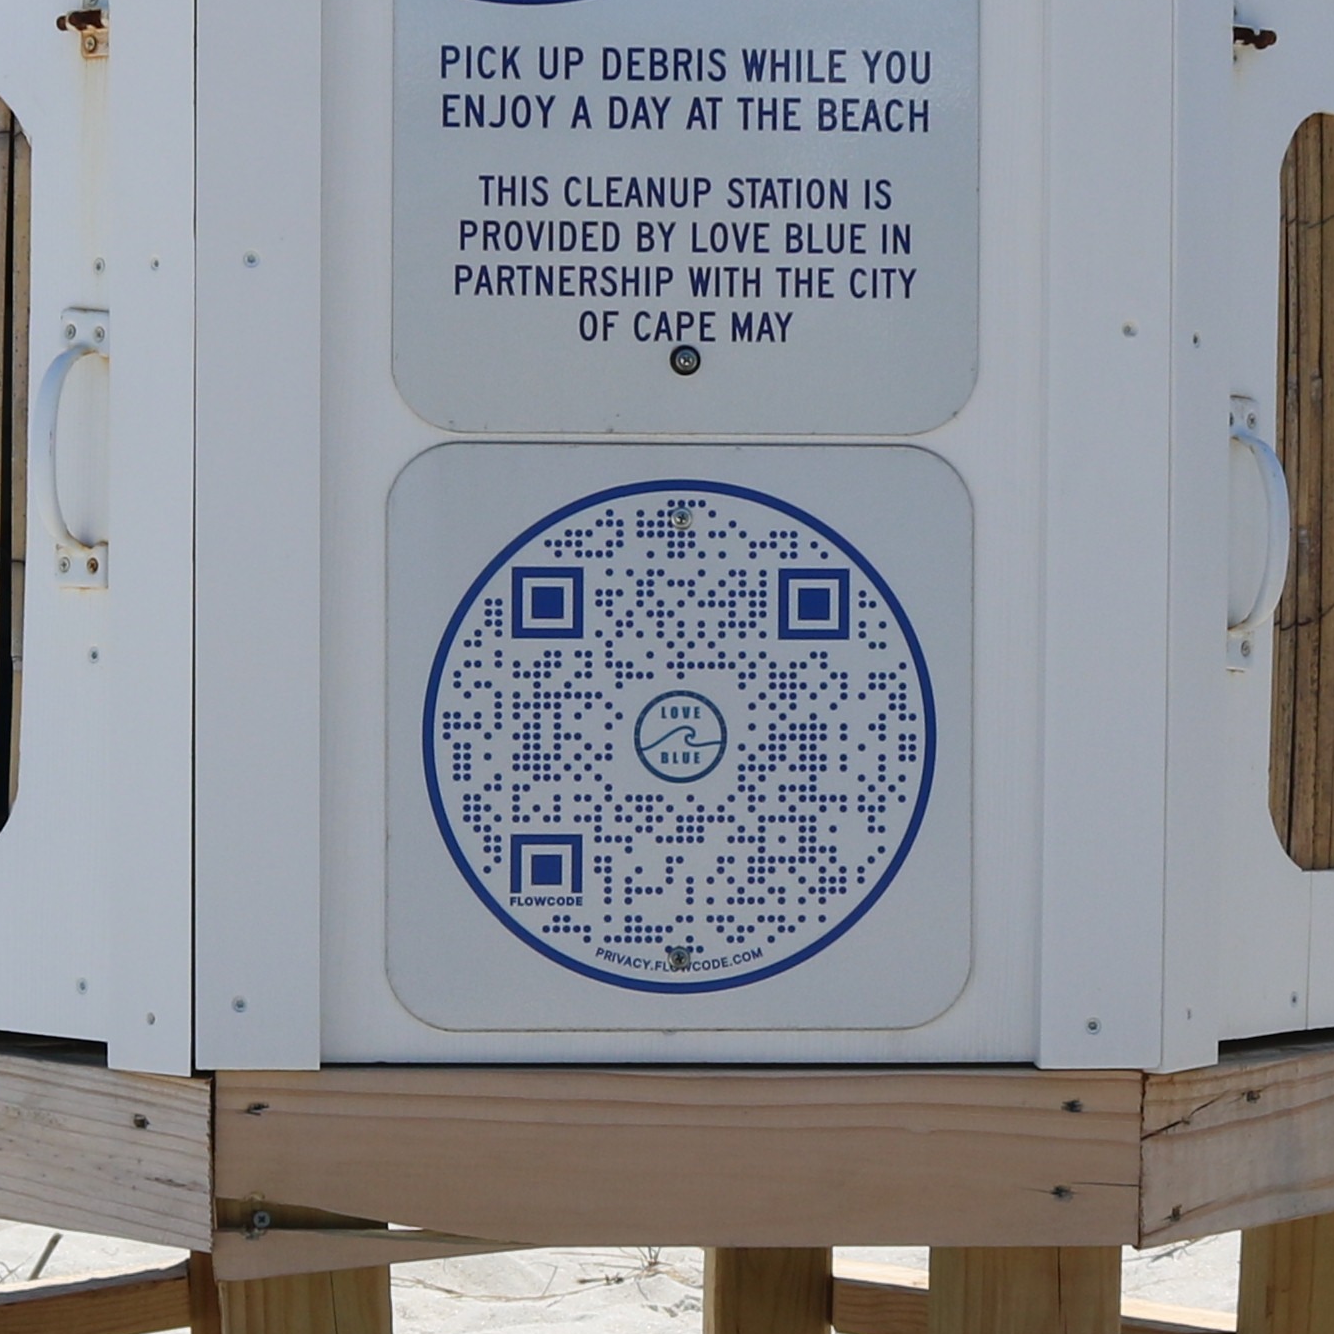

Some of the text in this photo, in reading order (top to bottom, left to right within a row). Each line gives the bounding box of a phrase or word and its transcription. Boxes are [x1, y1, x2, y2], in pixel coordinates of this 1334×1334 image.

[440, 45, 931, 85] PICK UP DEBRIS WHILE YOU
[442, 94, 929, 133] ENJOY A DAY AT THE BEACH
[478, 175, 892, 211] THIS CLEANUP STATION IS
[459, 219, 911, 255] PROVIDED BY LOVE BLUE IN
[454, 264, 917, 299] PARTNERSHIP WITH THE CITY
[579, 310, 793, 343] OF CAPE MAY
[661, 706, 701, 719] LOVE
[661, 752, 701, 764] BLUE
[509, 896, 583, 906] FLOWCODE
